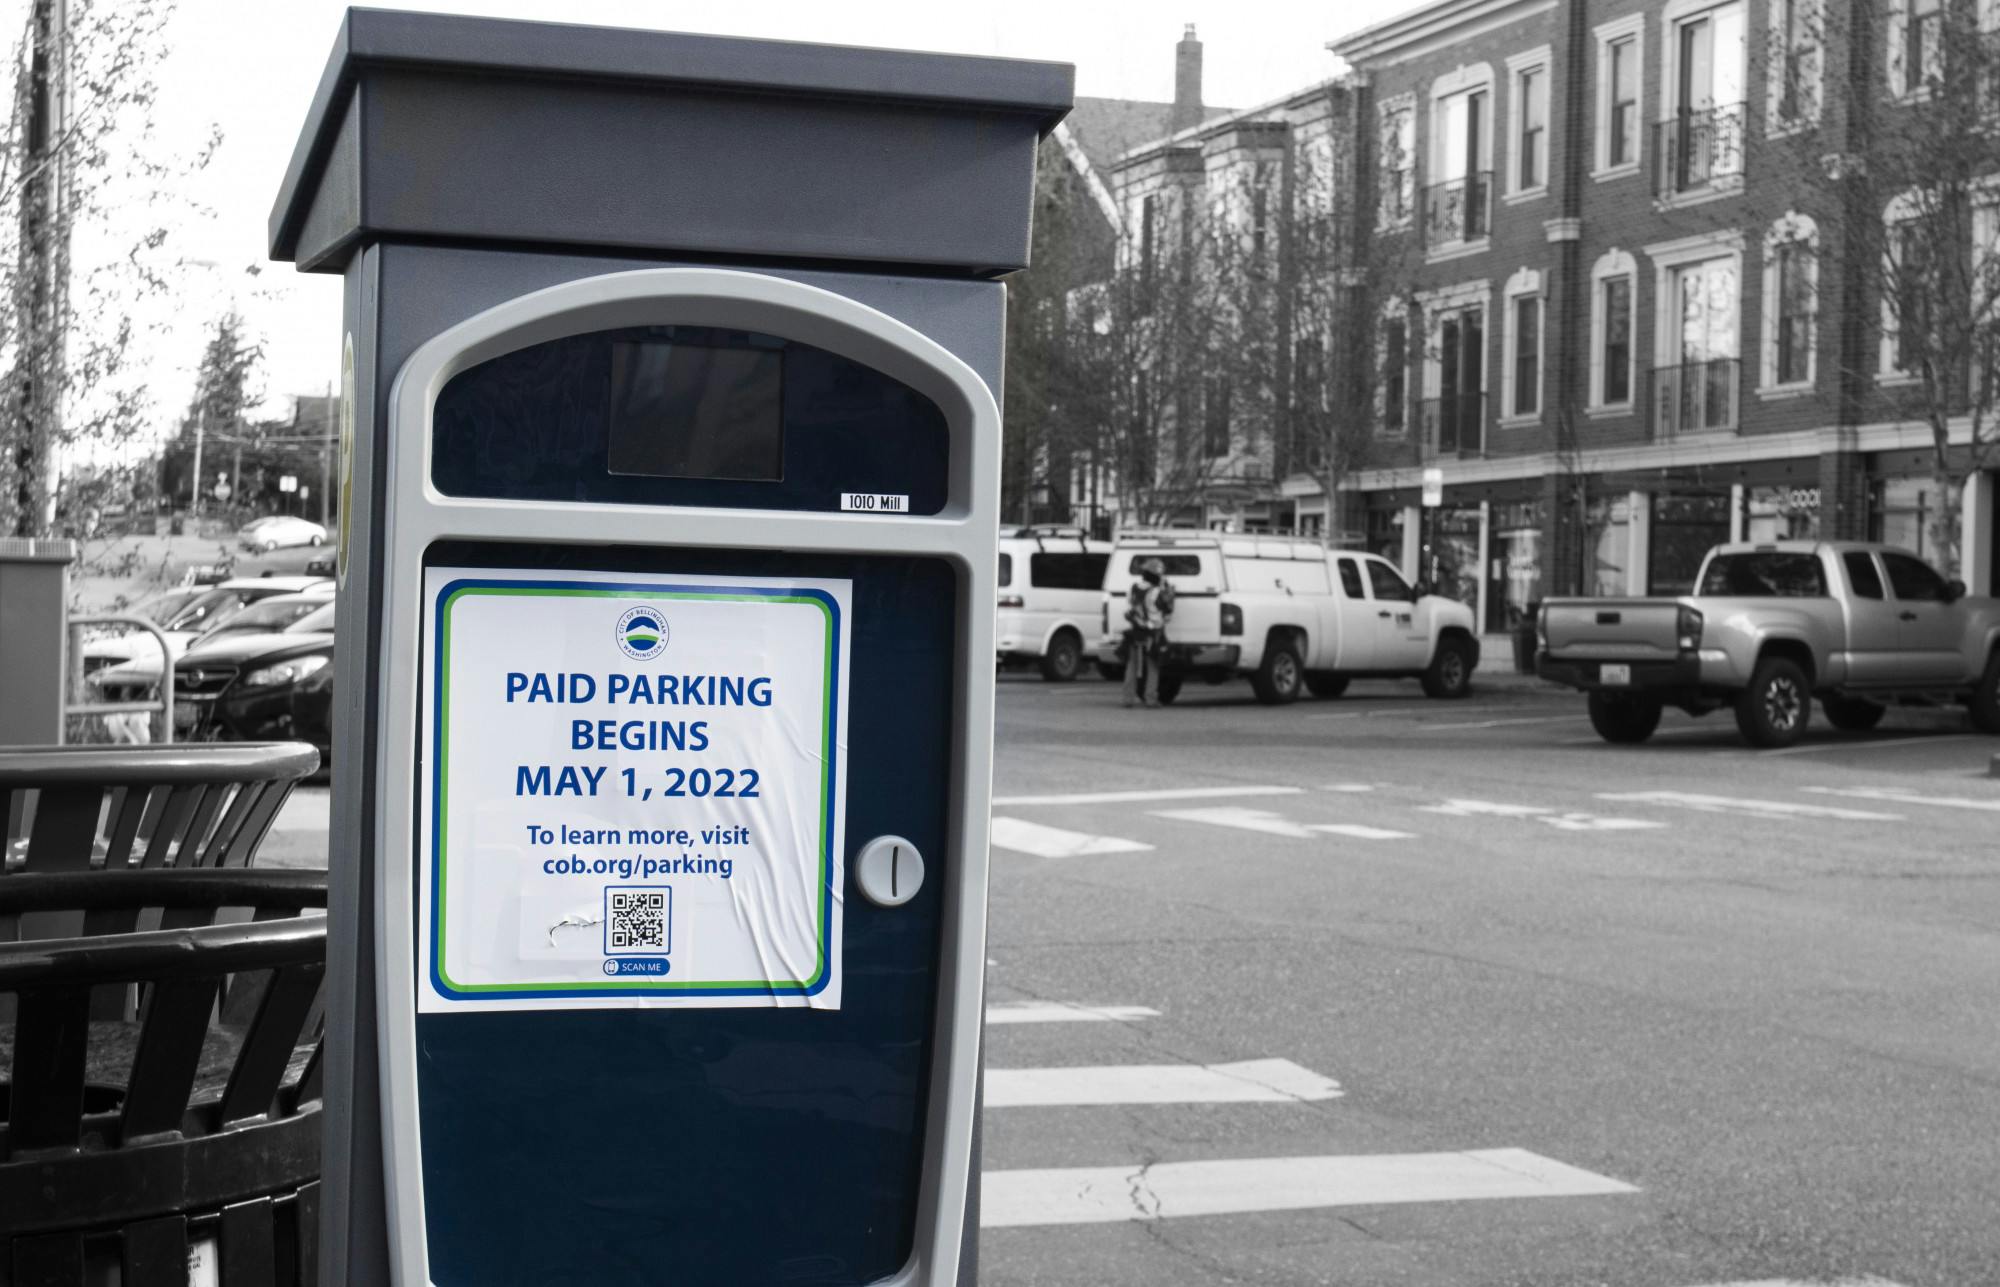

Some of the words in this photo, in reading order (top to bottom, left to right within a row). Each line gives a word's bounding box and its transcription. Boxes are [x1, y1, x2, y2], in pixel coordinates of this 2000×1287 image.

[849, 494, 875, 509] 1010
[880, 495, 900, 510] Mill
[619, 620, 627, 634] CITY
[626, 611, 634, 620] OF
[636, 609, 666, 634] BELLINGHAM
[624, 645, 662, 658] WASHINGTON
[506, 672, 597, 704] PAID
[607, 674, 773, 707] PARKING
[571, 719, 709, 752] BEGINS
[515, 765, 607, 797] MAY
[622, 767, 652, 801] 1,
[664, 767, 760, 798] 2022
[527, 825, 555, 845] To
[561, 824, 621, 845] learn
[628, 831, 695, 847] more,
[701, 824, 750, 845] visit
[543, 854, 733, 880] cob.org/parking
[622, 963, 646, 972] SCAN
[647, 963, 662, 972] ME
